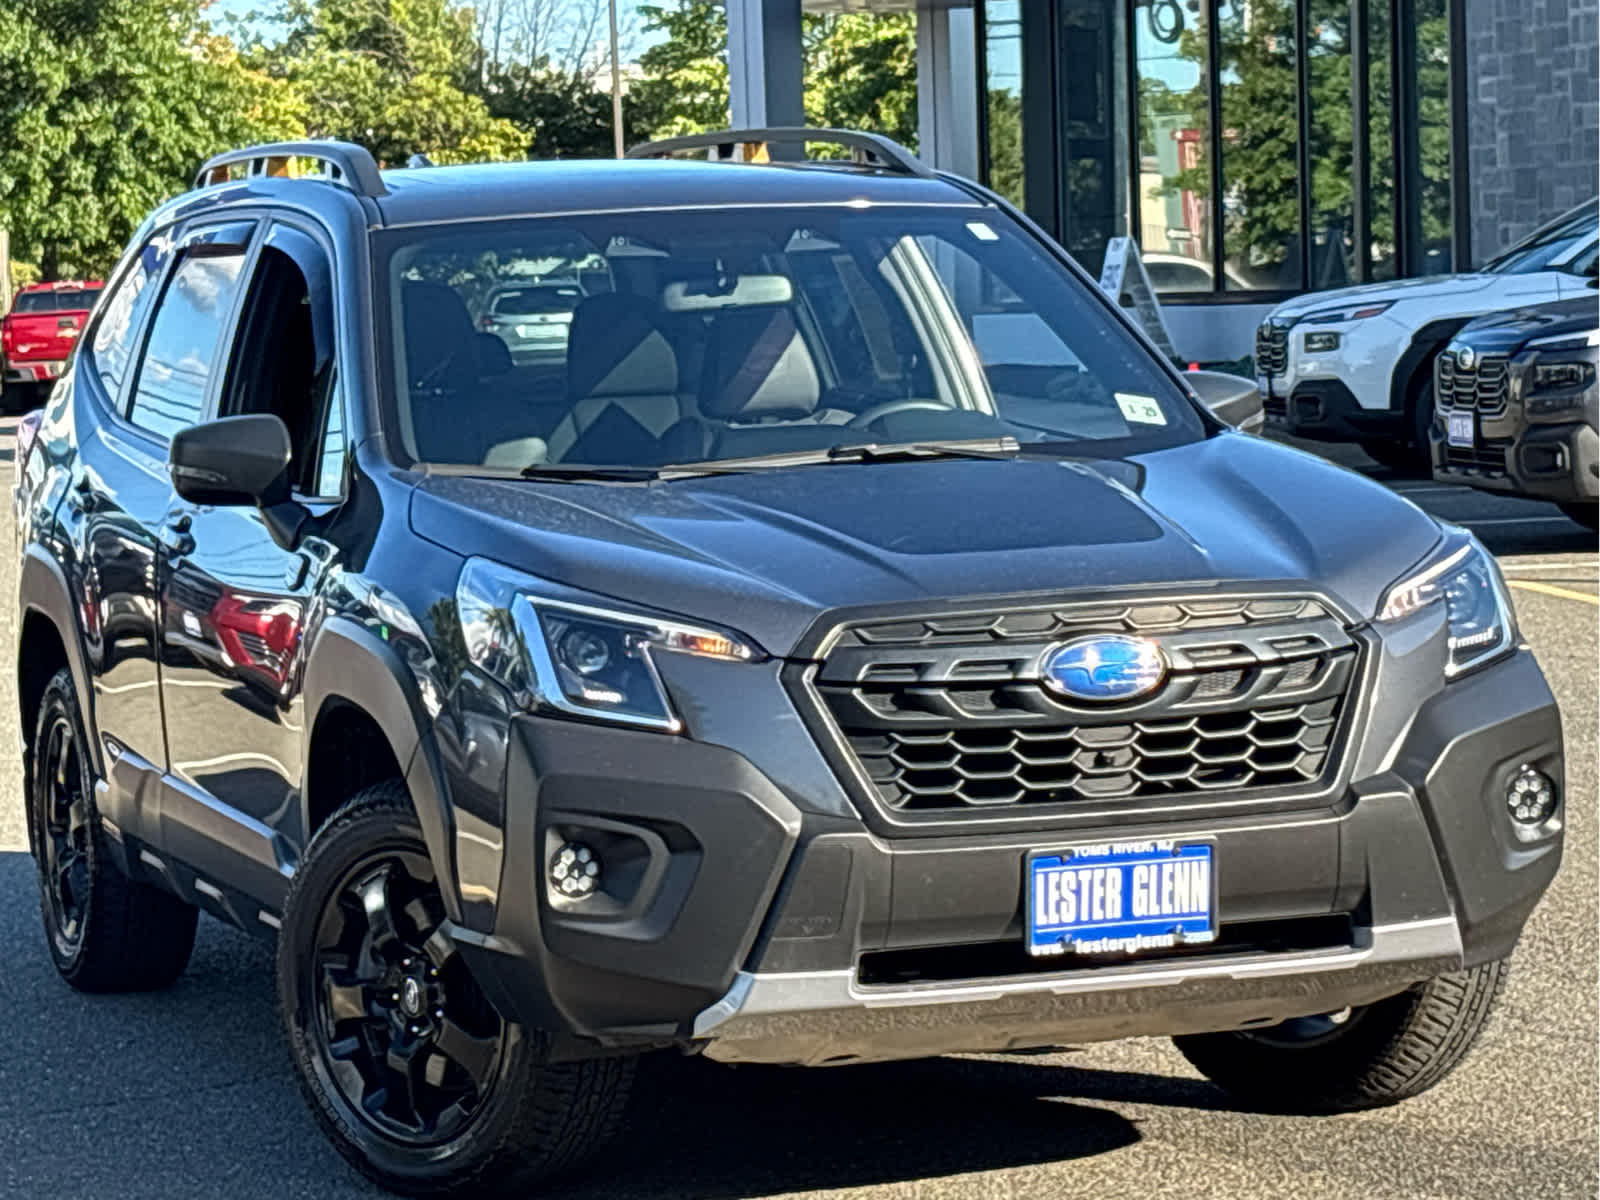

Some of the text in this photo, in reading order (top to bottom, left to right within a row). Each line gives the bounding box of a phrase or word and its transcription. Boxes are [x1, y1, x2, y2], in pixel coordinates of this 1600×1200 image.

[1073, 844, 1110, 858] TOMS
[1036, 861, 1209, 925] LESTER GLENN
